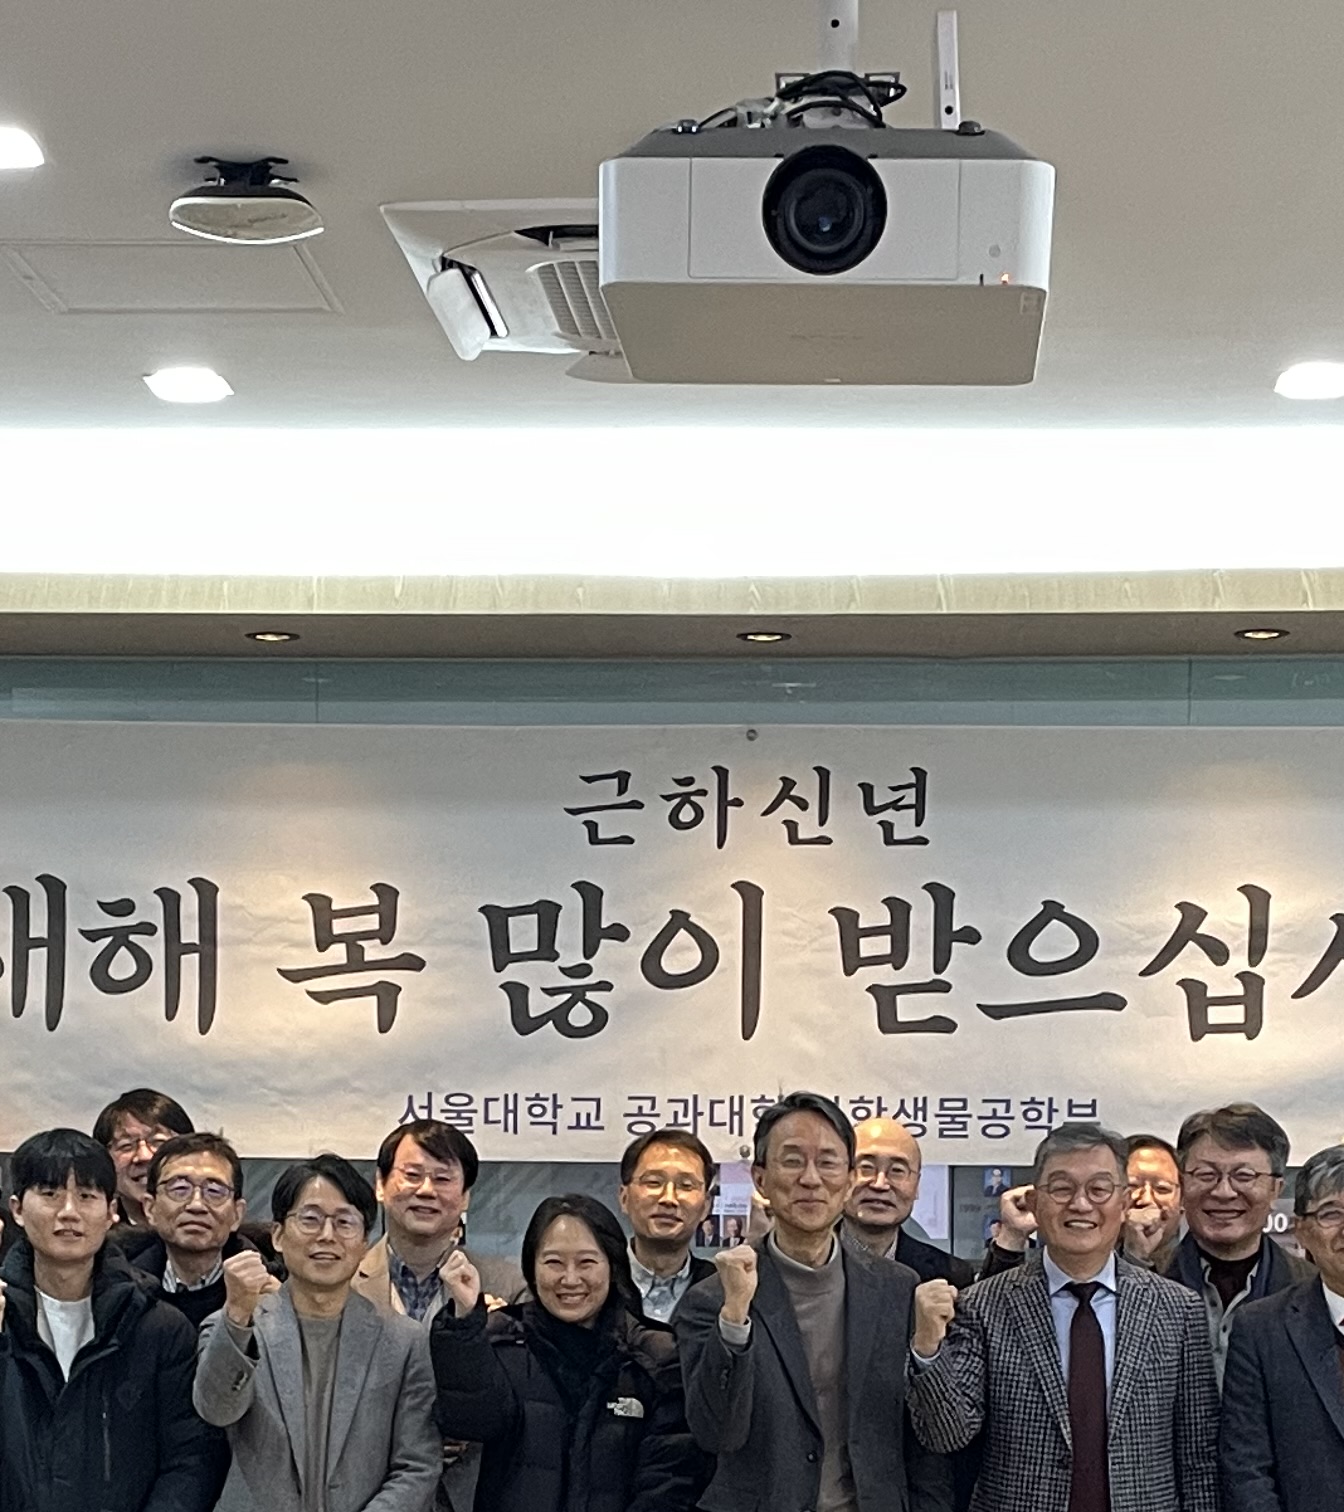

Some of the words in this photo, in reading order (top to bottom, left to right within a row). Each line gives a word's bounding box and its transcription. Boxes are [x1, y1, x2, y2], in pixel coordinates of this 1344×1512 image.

[564, 765, 930, 850] 근하신년
[276, 882, 426, 1035] 복
[478, 880, 765, 1042] 많이
[398, 1091, 605, 1136] 서울대학교
[833, 1095, 1101, 1139] 학생물공학부
